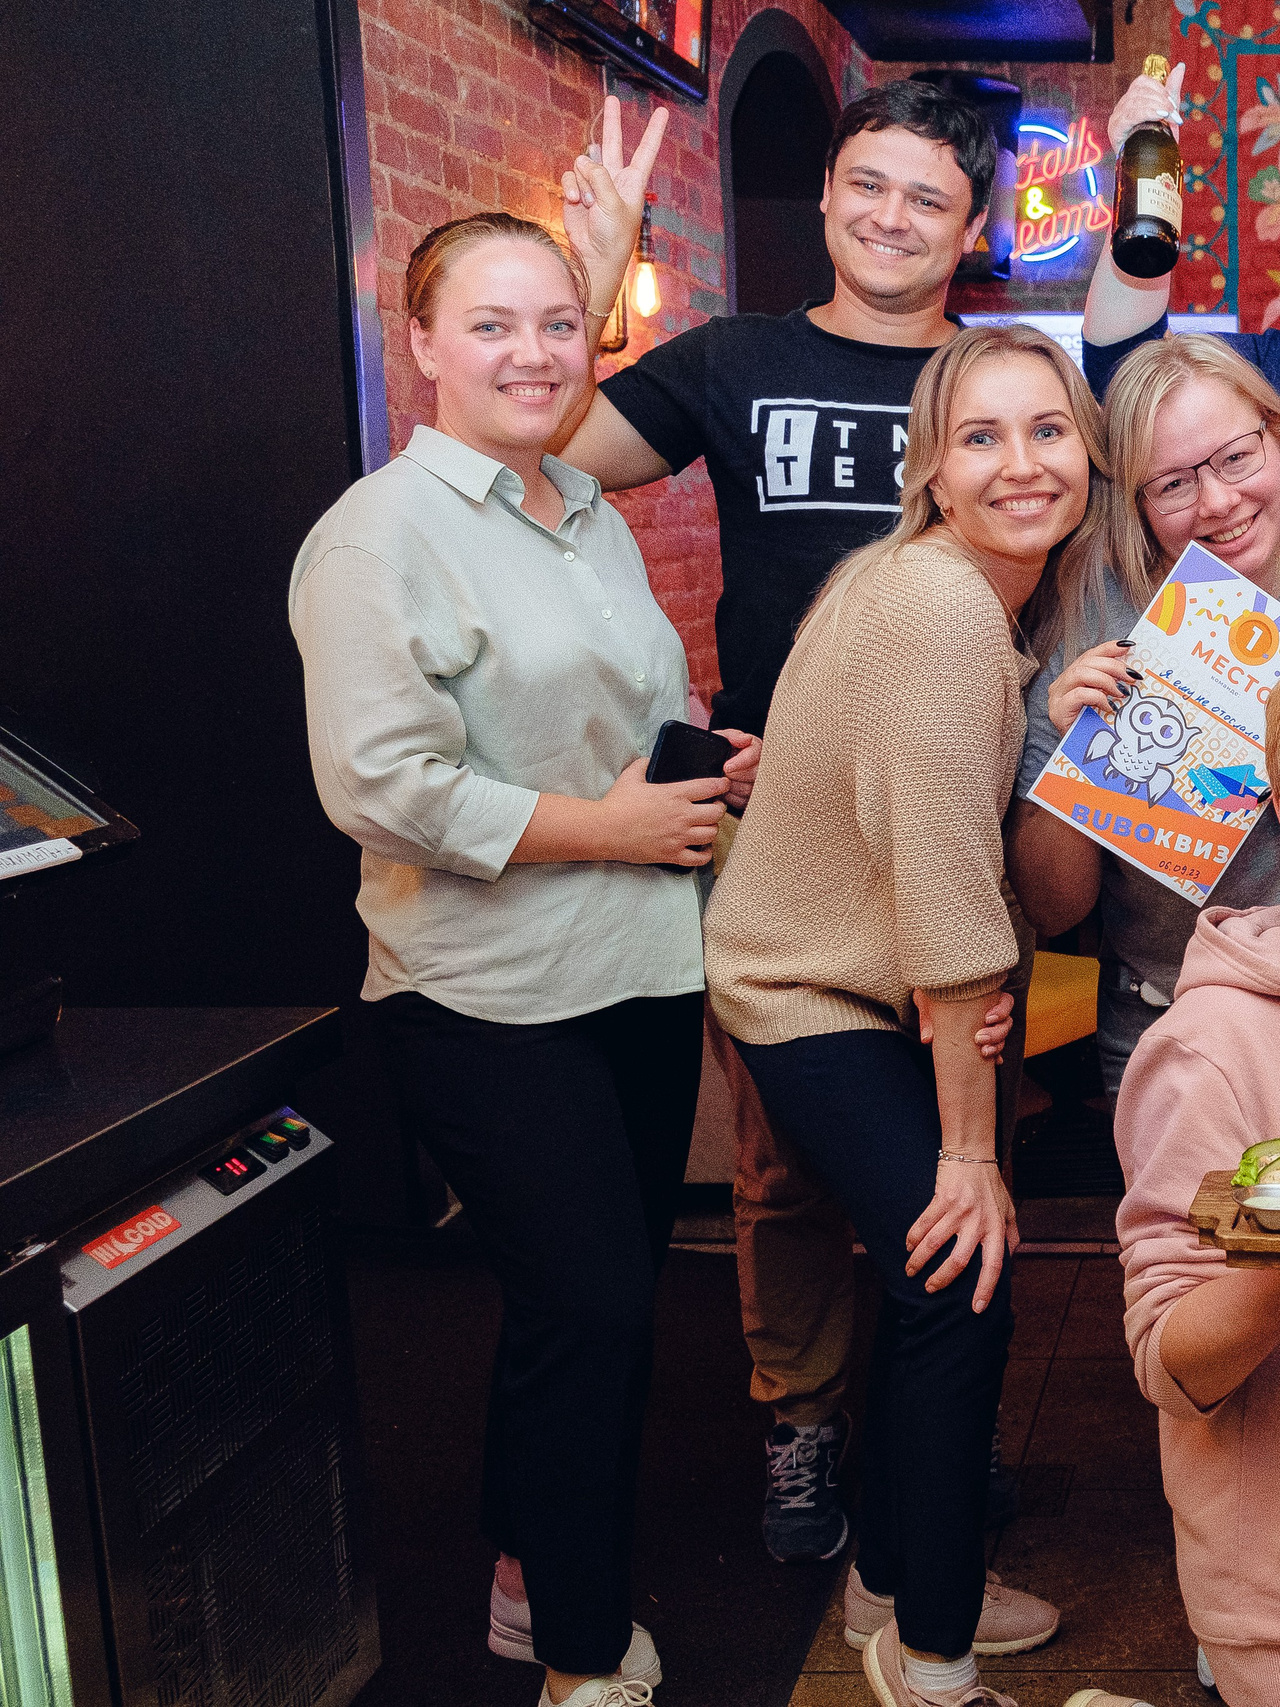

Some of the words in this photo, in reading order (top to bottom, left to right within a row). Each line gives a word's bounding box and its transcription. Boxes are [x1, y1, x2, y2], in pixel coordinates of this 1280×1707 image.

[1025, 185, 1054, 220] &
[1245, 625, 1264, 652] 1
[1159, 669, 1174, 679] Я
[1195, 695, 1210, 706] не
[1191, 640, 1272, 704] МЕСТО
